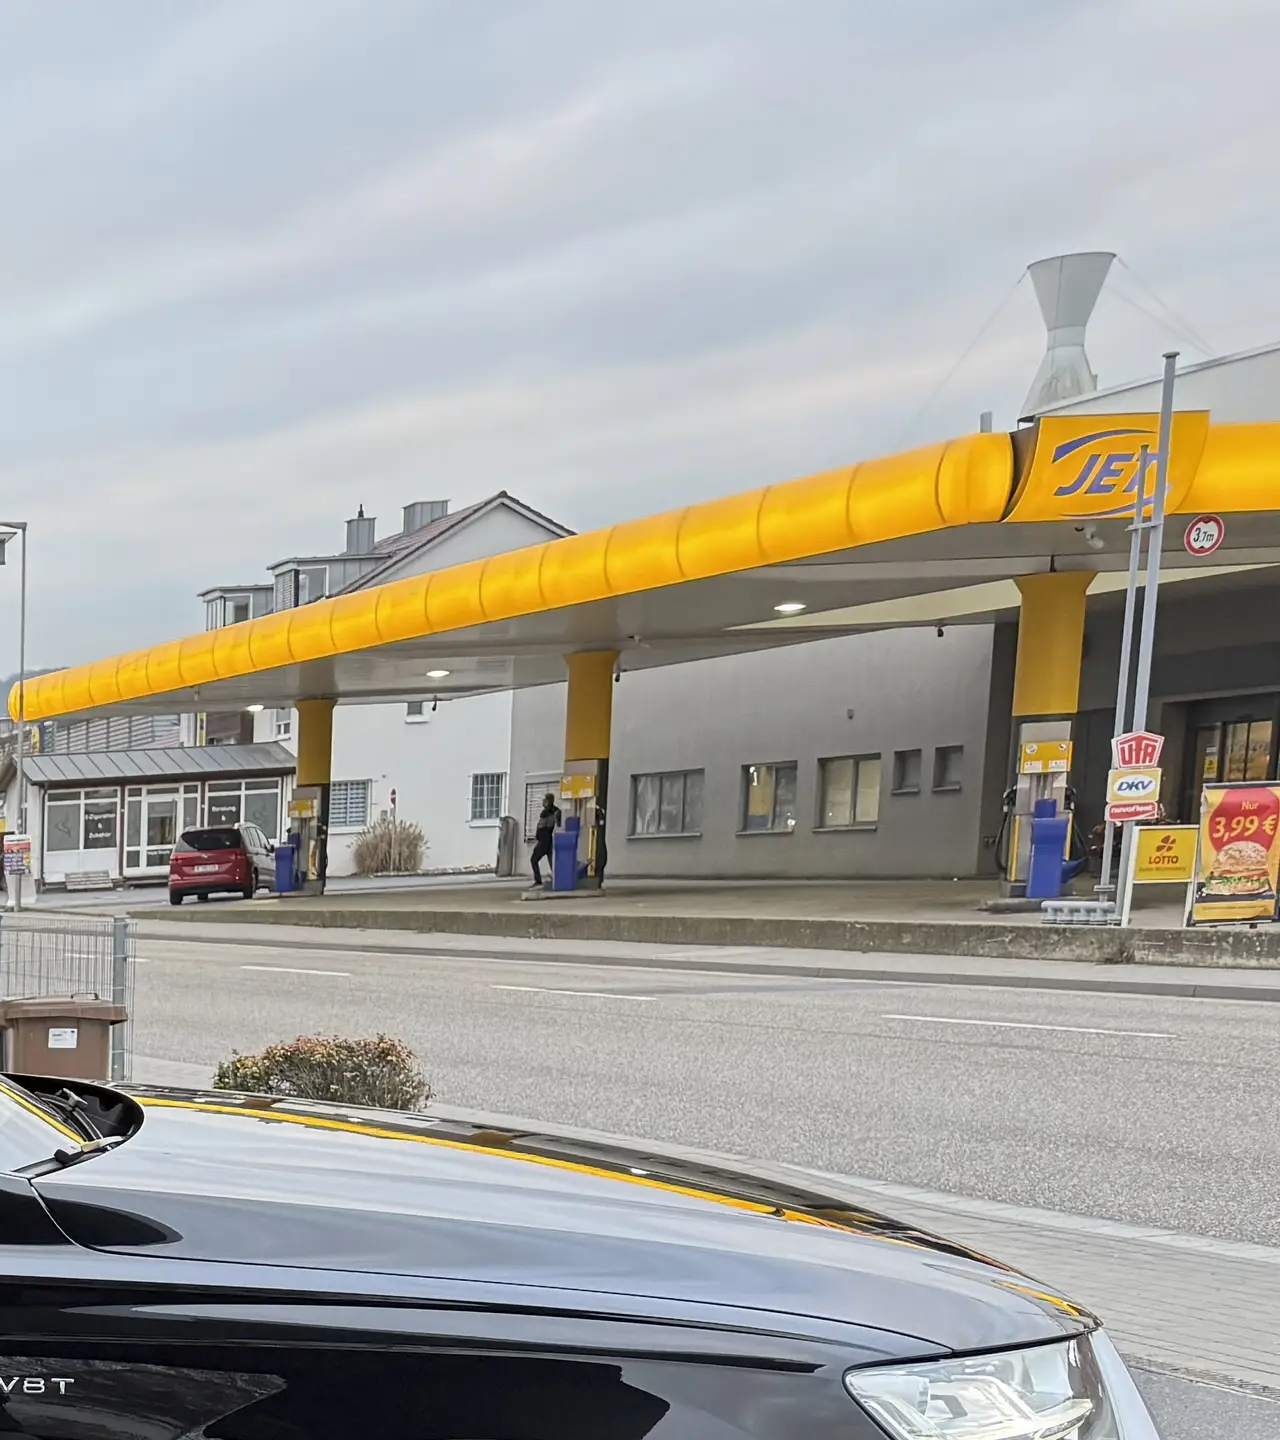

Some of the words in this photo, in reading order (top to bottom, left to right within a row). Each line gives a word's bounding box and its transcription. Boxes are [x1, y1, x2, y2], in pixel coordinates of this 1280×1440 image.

[1119, 735, 1159, 766] UTA
[1117, 780, 1153, 791] DKV
[1241, 801, 1259, 810] Nur
[1212, 815, 1259, 842] 3,99
[1262, 814, 1278, 835] €
[1148, 855, 1179, 865] LOTTO
